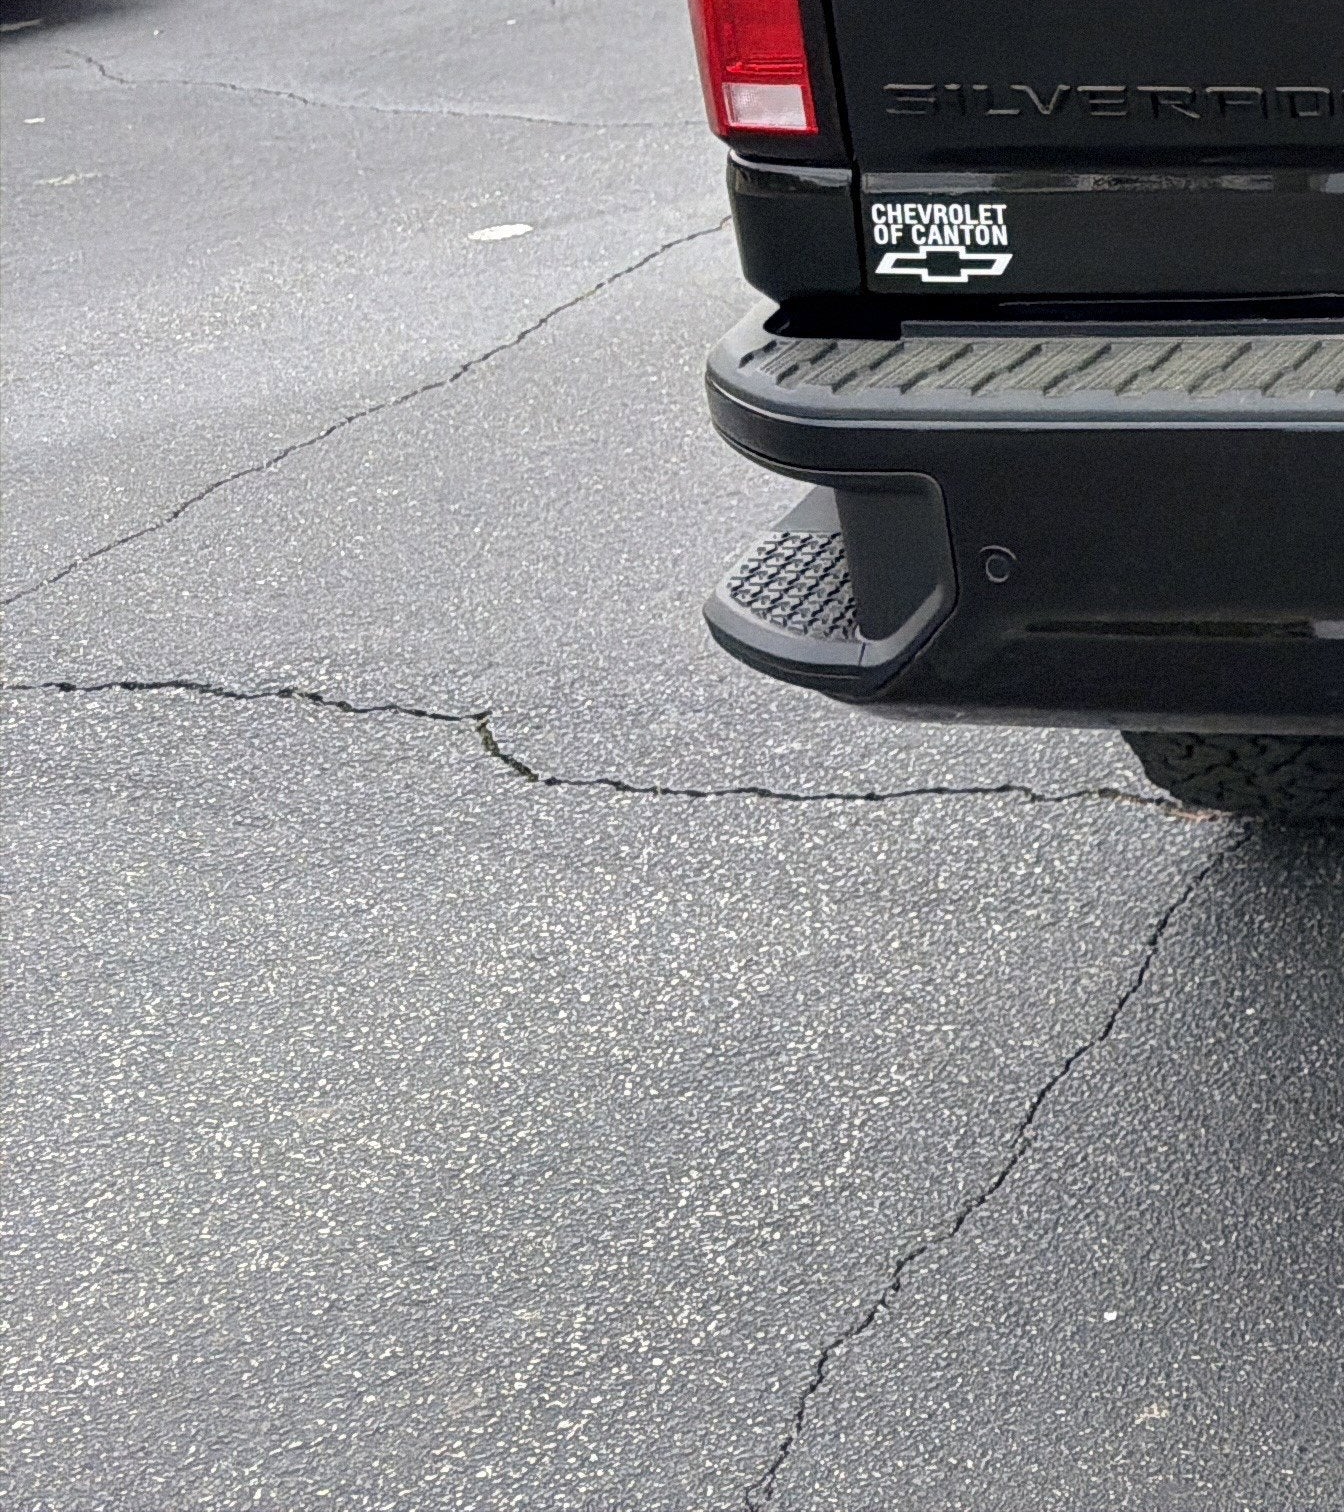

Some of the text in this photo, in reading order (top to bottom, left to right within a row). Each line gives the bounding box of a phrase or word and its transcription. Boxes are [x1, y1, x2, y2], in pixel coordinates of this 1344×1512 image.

[871, 203, 1007, 225] CHEVROLET
[873, 224, 1008, 246] OF CANTON
